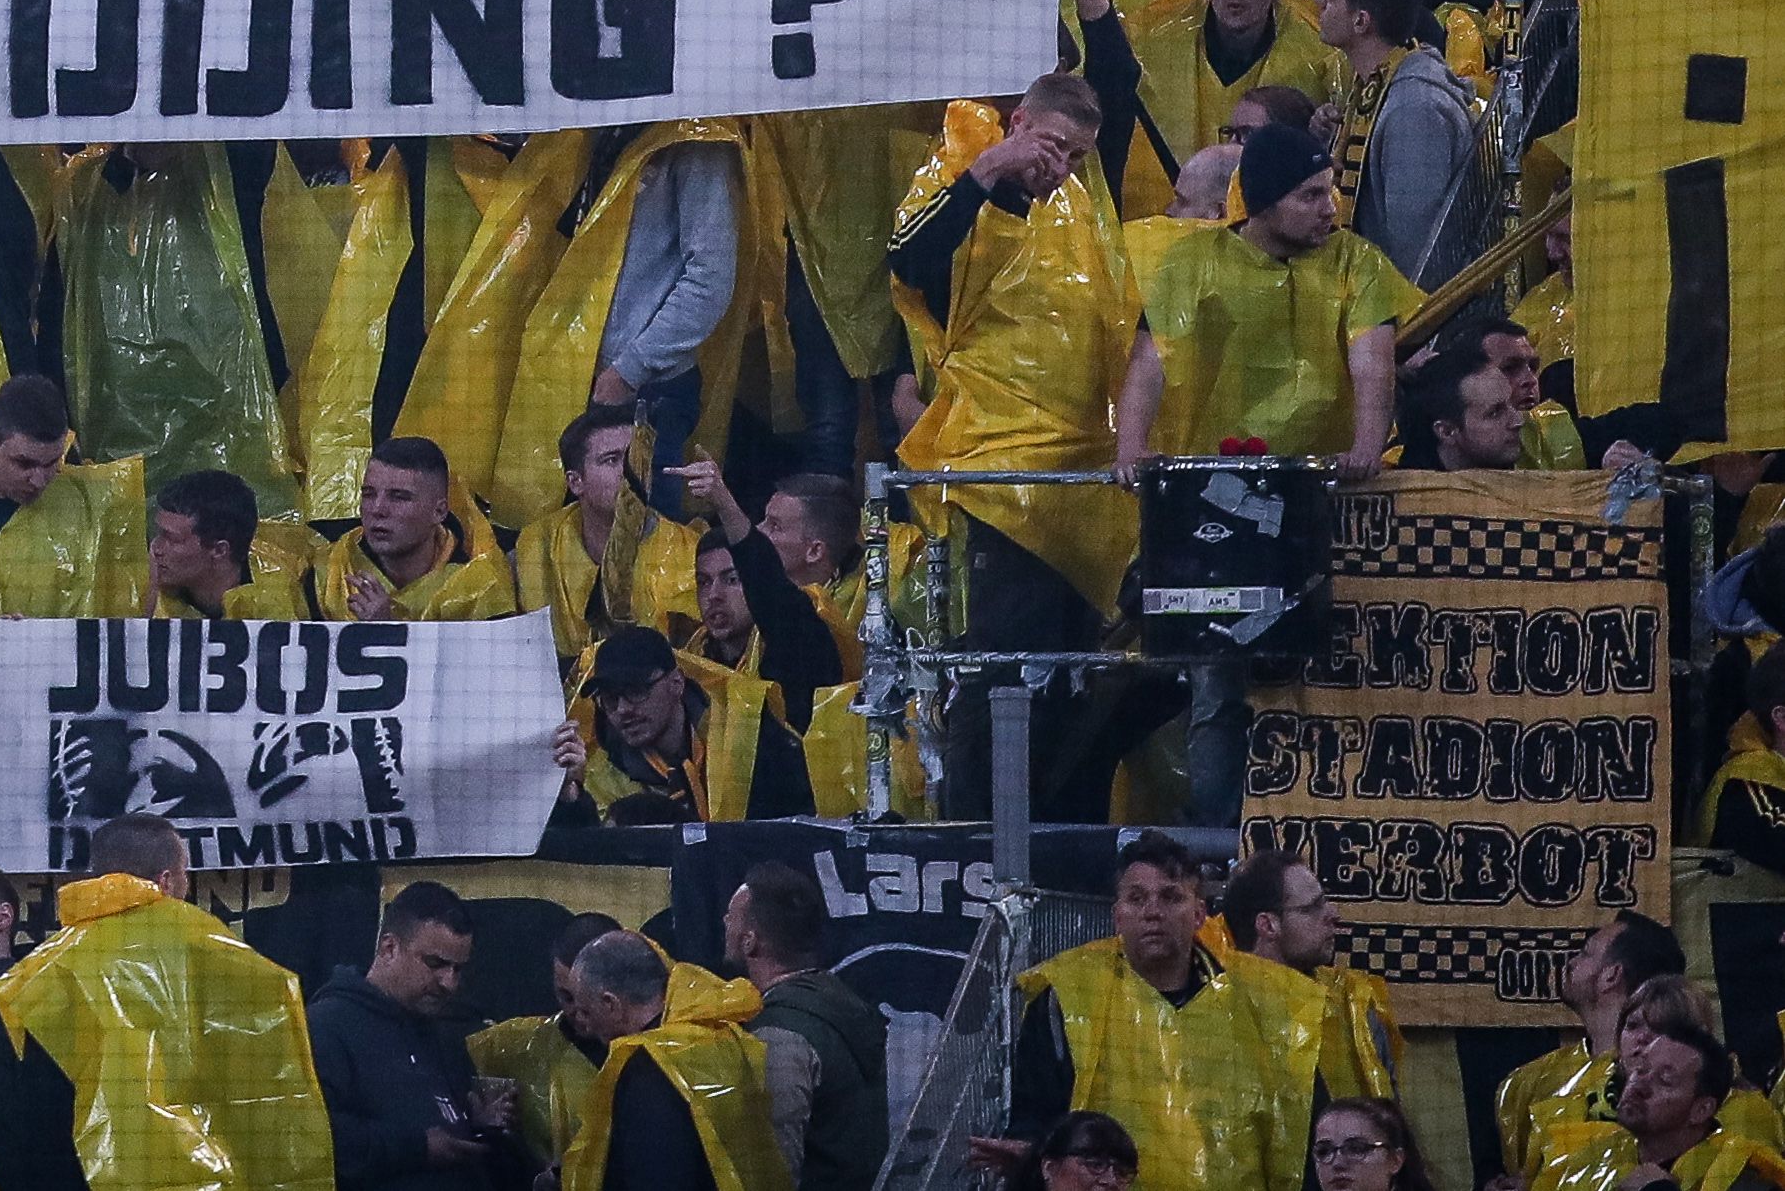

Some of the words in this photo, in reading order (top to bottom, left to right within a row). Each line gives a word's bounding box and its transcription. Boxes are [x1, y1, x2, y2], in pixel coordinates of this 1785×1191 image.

[48, 618, 409, 714] JUBOS
[1250, 601, 1661, 697] EKTION
[1246, 710, 1657, 803] STADION
[48, 815, 417, 870] DTMUND
[813, 849, 994, 918] Lars
